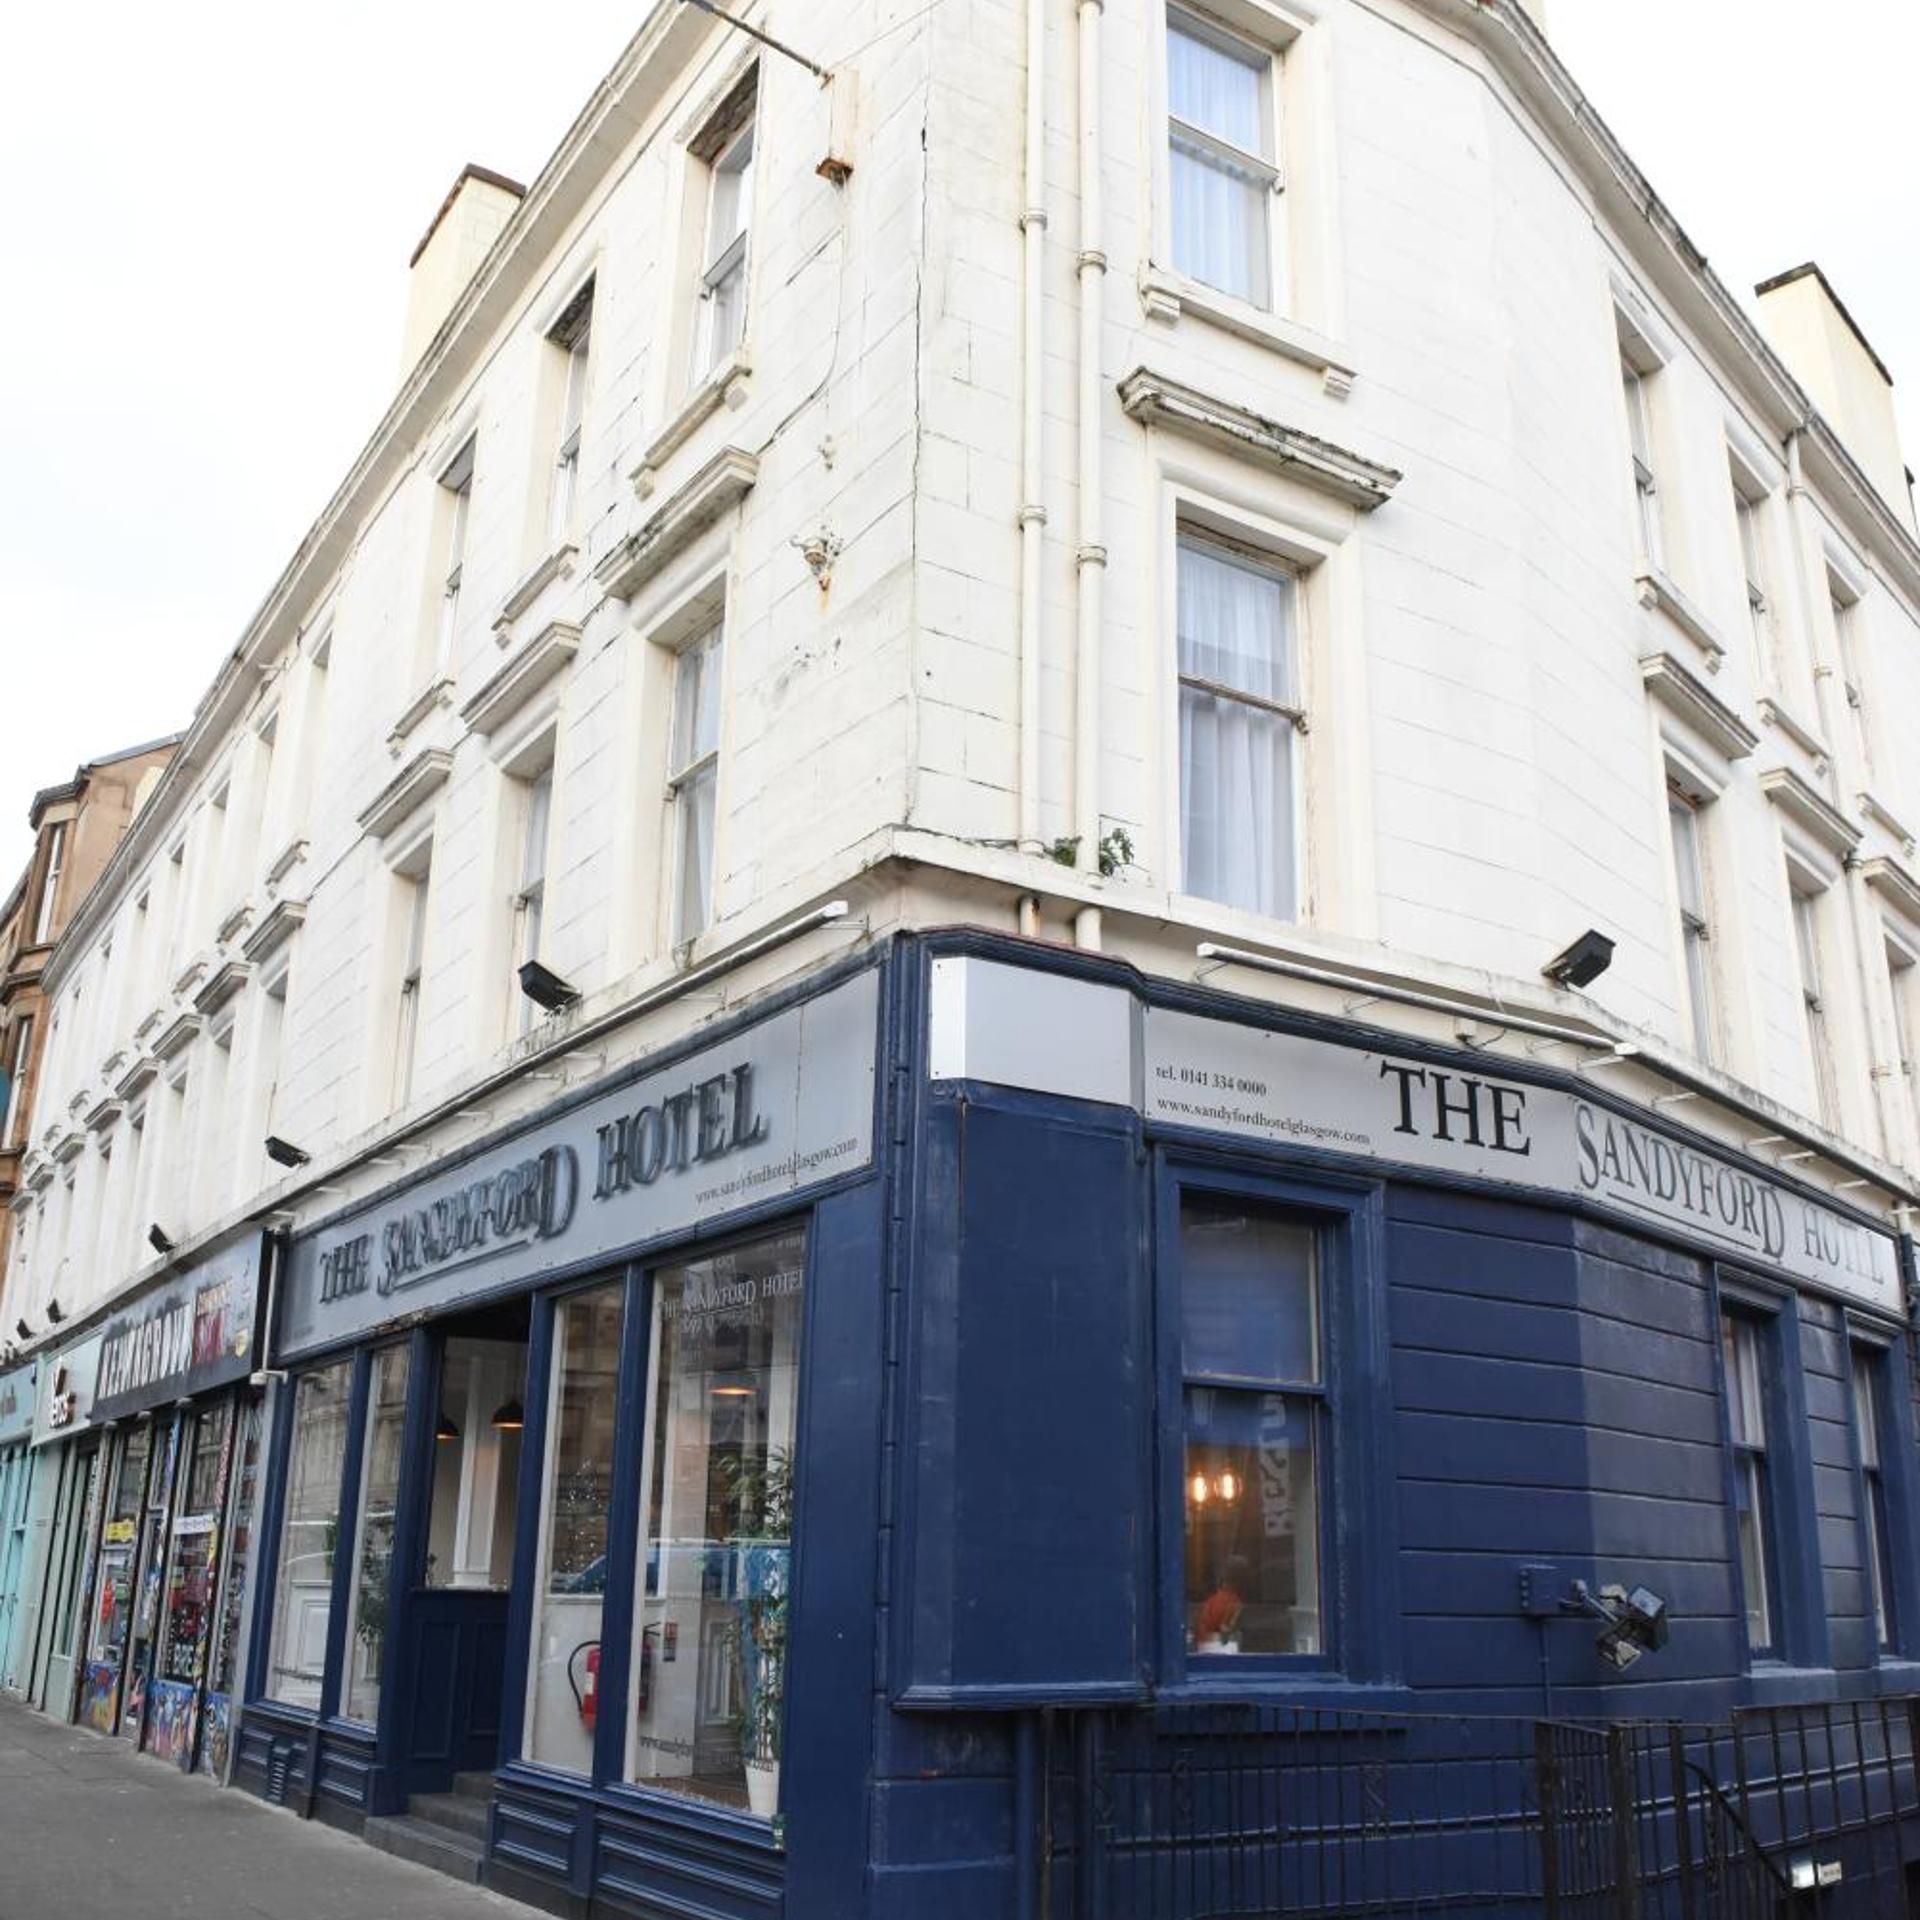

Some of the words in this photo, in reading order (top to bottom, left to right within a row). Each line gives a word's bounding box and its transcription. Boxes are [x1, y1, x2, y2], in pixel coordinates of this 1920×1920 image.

[1156, 1066, 1177, 1081] tel.
[1181, 1068, 1208, 1087] 0141
[1212, 1074, 1234, 1090] 334
[1237, 1079, 1267, 1097] 0000
[1157, 1098, 1370, 1145] www.sandyfordhotelglasgow.com
[319, 1235, 371, 1304] THE
[377, 1144, 580, 1296] SANDYFORD
[592, 1062, 769, 1202] HOTEL
[1380, 1060, 1530, 1156] THE
[1575, 1103, 1785, 1259] SANDYFORD
